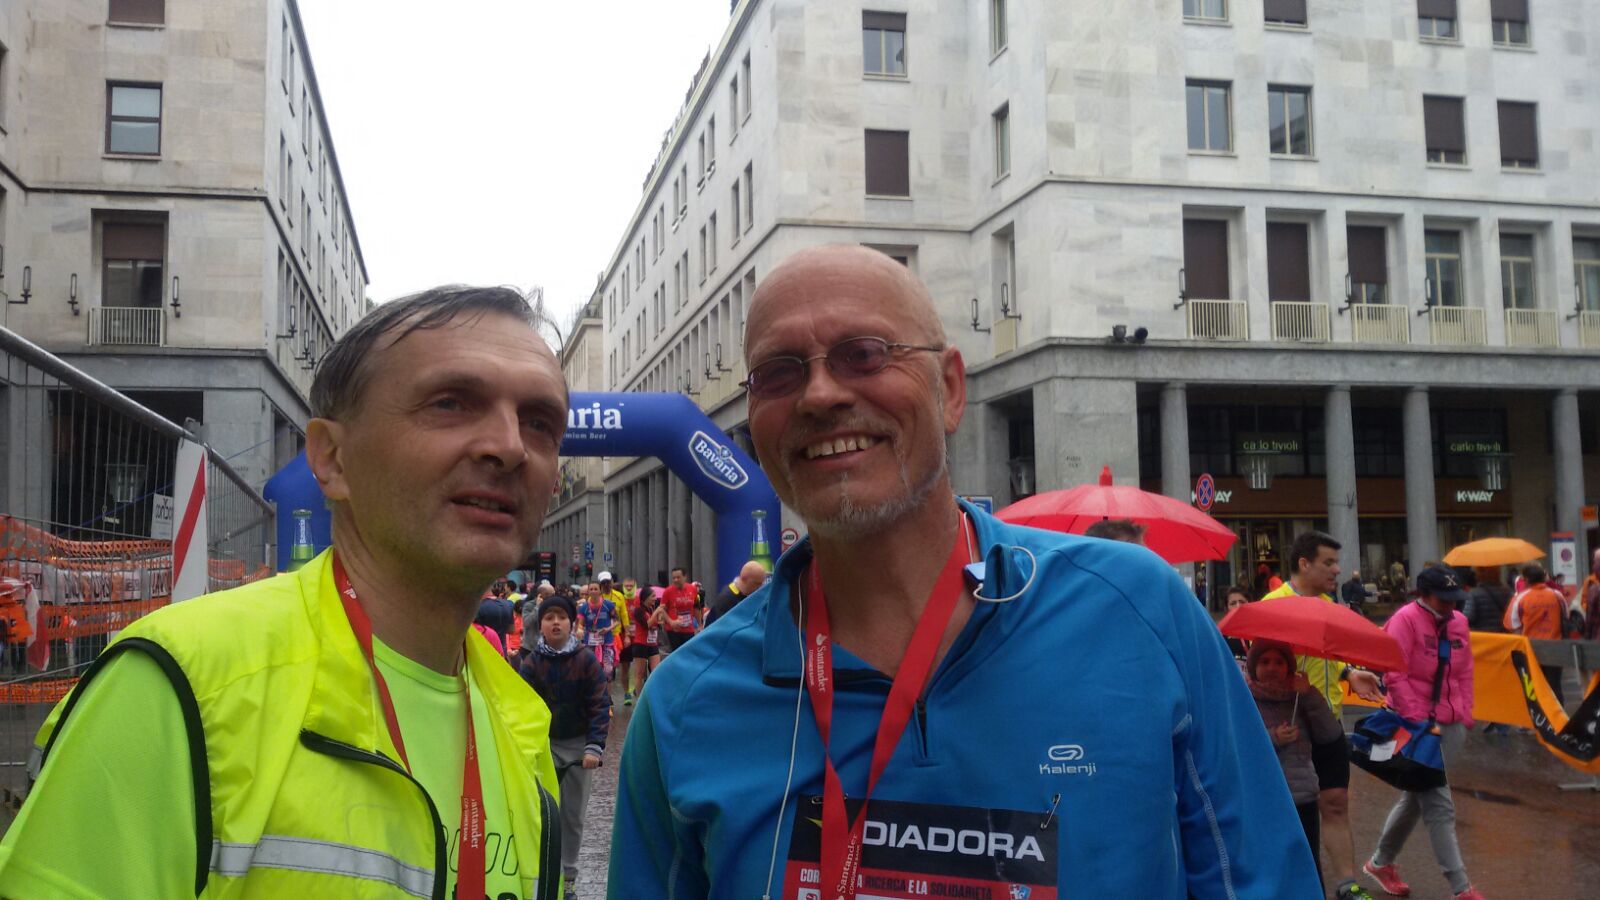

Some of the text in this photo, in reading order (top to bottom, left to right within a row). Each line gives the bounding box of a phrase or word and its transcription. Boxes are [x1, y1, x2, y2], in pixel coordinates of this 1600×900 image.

[695, 439, 738, 483] Bavaria
[1243, 440, 1269, 450] calo
[816, 646, 828, 692] Santander
[1039, 763, 1097, 777] Kalenji
[862, 820, 1045, 862] DIADORA
[837, 833, 857, 893] Santander
[908, 880, 914, 893] E
[916, 881, 927, 895] LA
